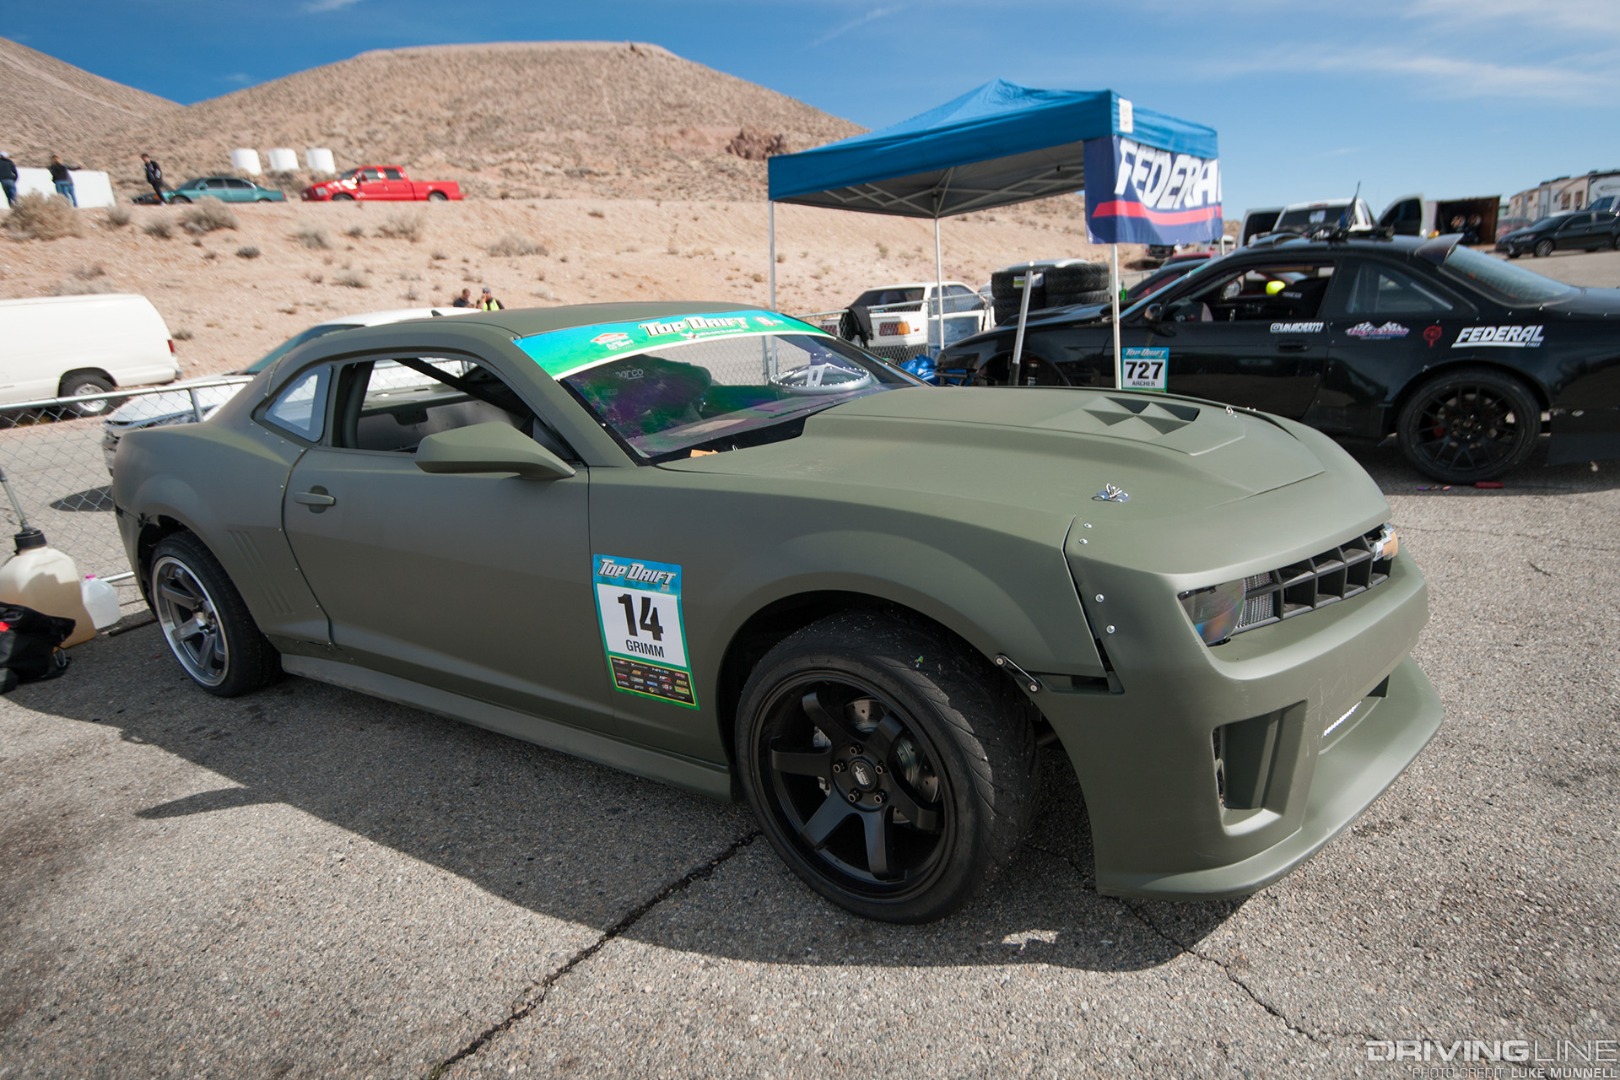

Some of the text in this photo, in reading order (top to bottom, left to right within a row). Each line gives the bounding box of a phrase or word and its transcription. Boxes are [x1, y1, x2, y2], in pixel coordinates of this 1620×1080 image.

[1114, 138, 1222, 210] FEDERA
[1456, 325, 1545, 342] FEDERAL
[1125, 361, 1163, 379] 727
[617, 593, 664, 641] 14
[625, 639, 665, 658] GRIMM
